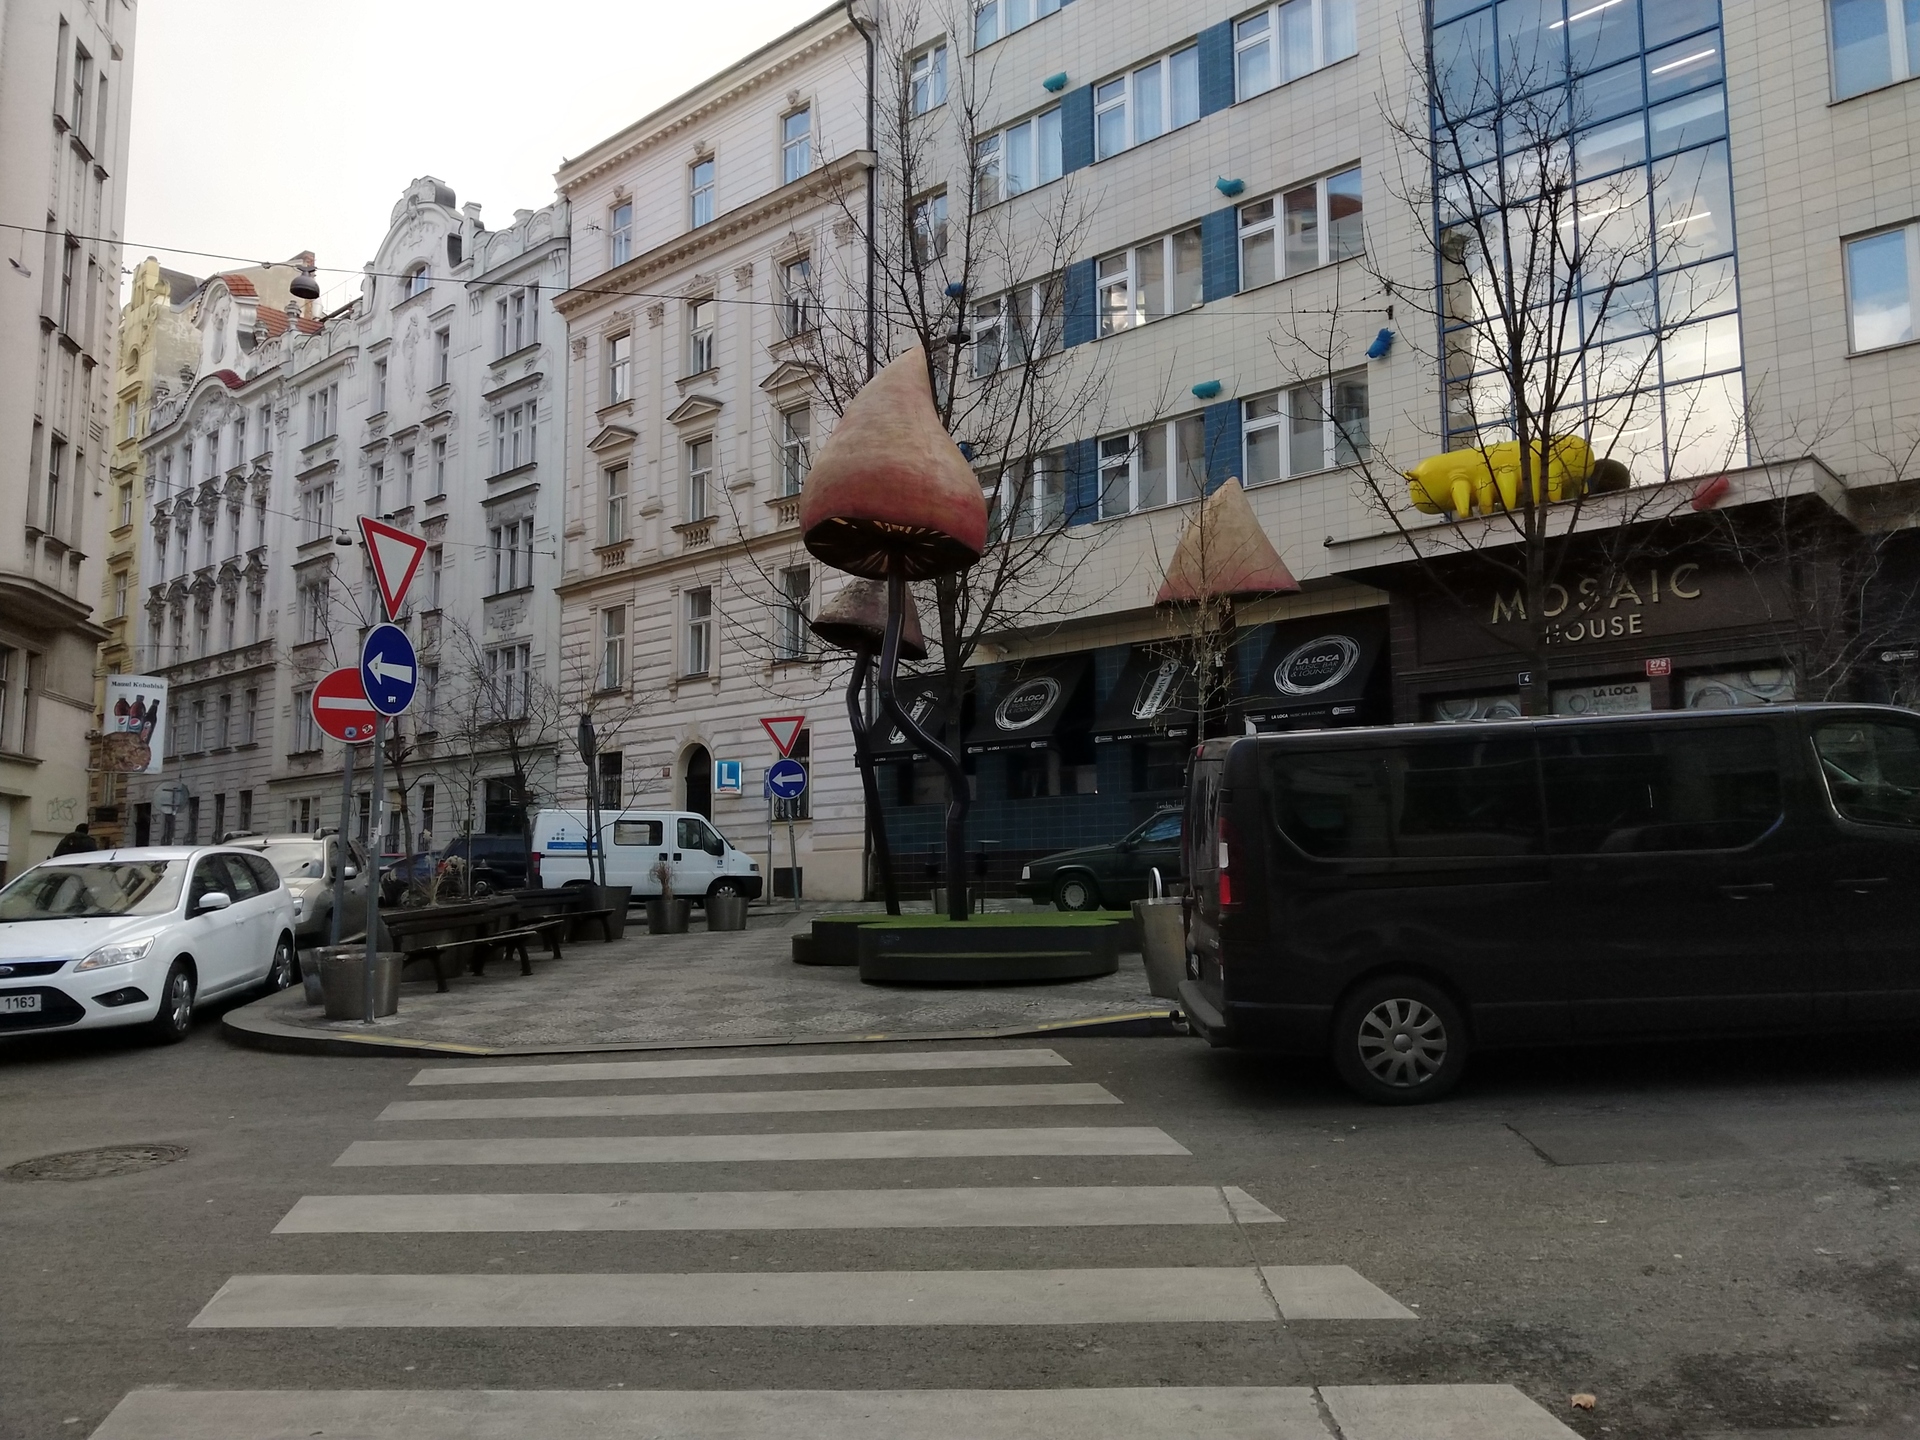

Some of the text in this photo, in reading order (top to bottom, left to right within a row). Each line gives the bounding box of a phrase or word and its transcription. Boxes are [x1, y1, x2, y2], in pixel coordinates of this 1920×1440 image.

[1491, 563, 1700, 624] MOSAIC
[1311, 654, 1340, 664] LOCA
[1650, 659, 1667, 668] 276
[1293, 663, 1319, 671] MUSIC
[1299, 667, 1335, 677] LOUNGE
[1524, 674, 1530, 683] 4
[1593, 685, 1638, 698] LA LOCA
[1024, 693, 1045, 702] LOCA
[722, 763, 736, 785] L
[5, 996, 35, 1010] 1163
